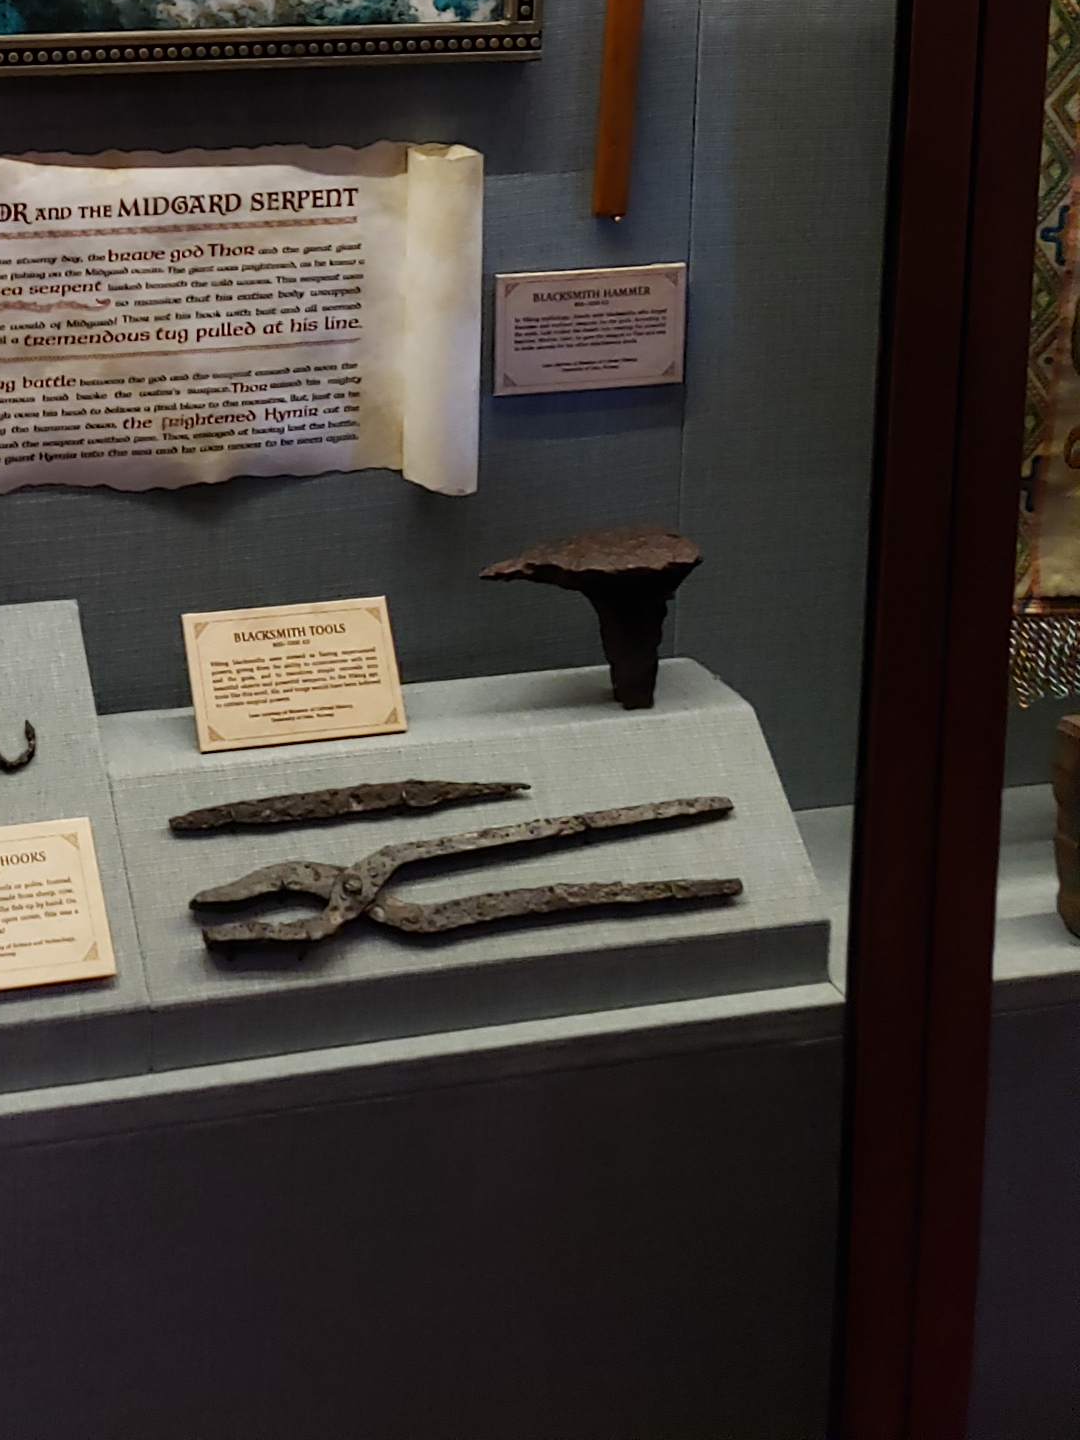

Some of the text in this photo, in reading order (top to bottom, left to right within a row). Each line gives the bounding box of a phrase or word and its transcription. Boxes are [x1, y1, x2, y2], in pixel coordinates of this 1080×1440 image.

[35, 206, 72, 221] AND
[78, 204, 112, 218] THE
[117, 193, 242, 218] MIDGARD
[250, 188, 358, 214] SERPENT
[108, 249, 165, 262] brave
[170, 246, 204, 263] god
[207, 243, 255, 257] Thor
[29, 281, 102, 297] serpent
[533, 286, 651, 303] BLACKSMITH HAMMER
[24, 330, 150, 347] tremendous
[156, 326, 188, 344] tug
[196, 321, 255, 342] pulled
[262, 320, 283, 335] at
[290, 318, 318, 332] his
[324, 316, 363, 330] line.
[22, 375, 76, 389] battle
[231, 382, 268, 394] Thor
[122, 405, 318, 430] the frightened Hymir
[234, 626, 306, 643] BLACKSMITH
[310, 624, 346, 635] TOOLS
[0, 851, 46, 867] HOOKS
